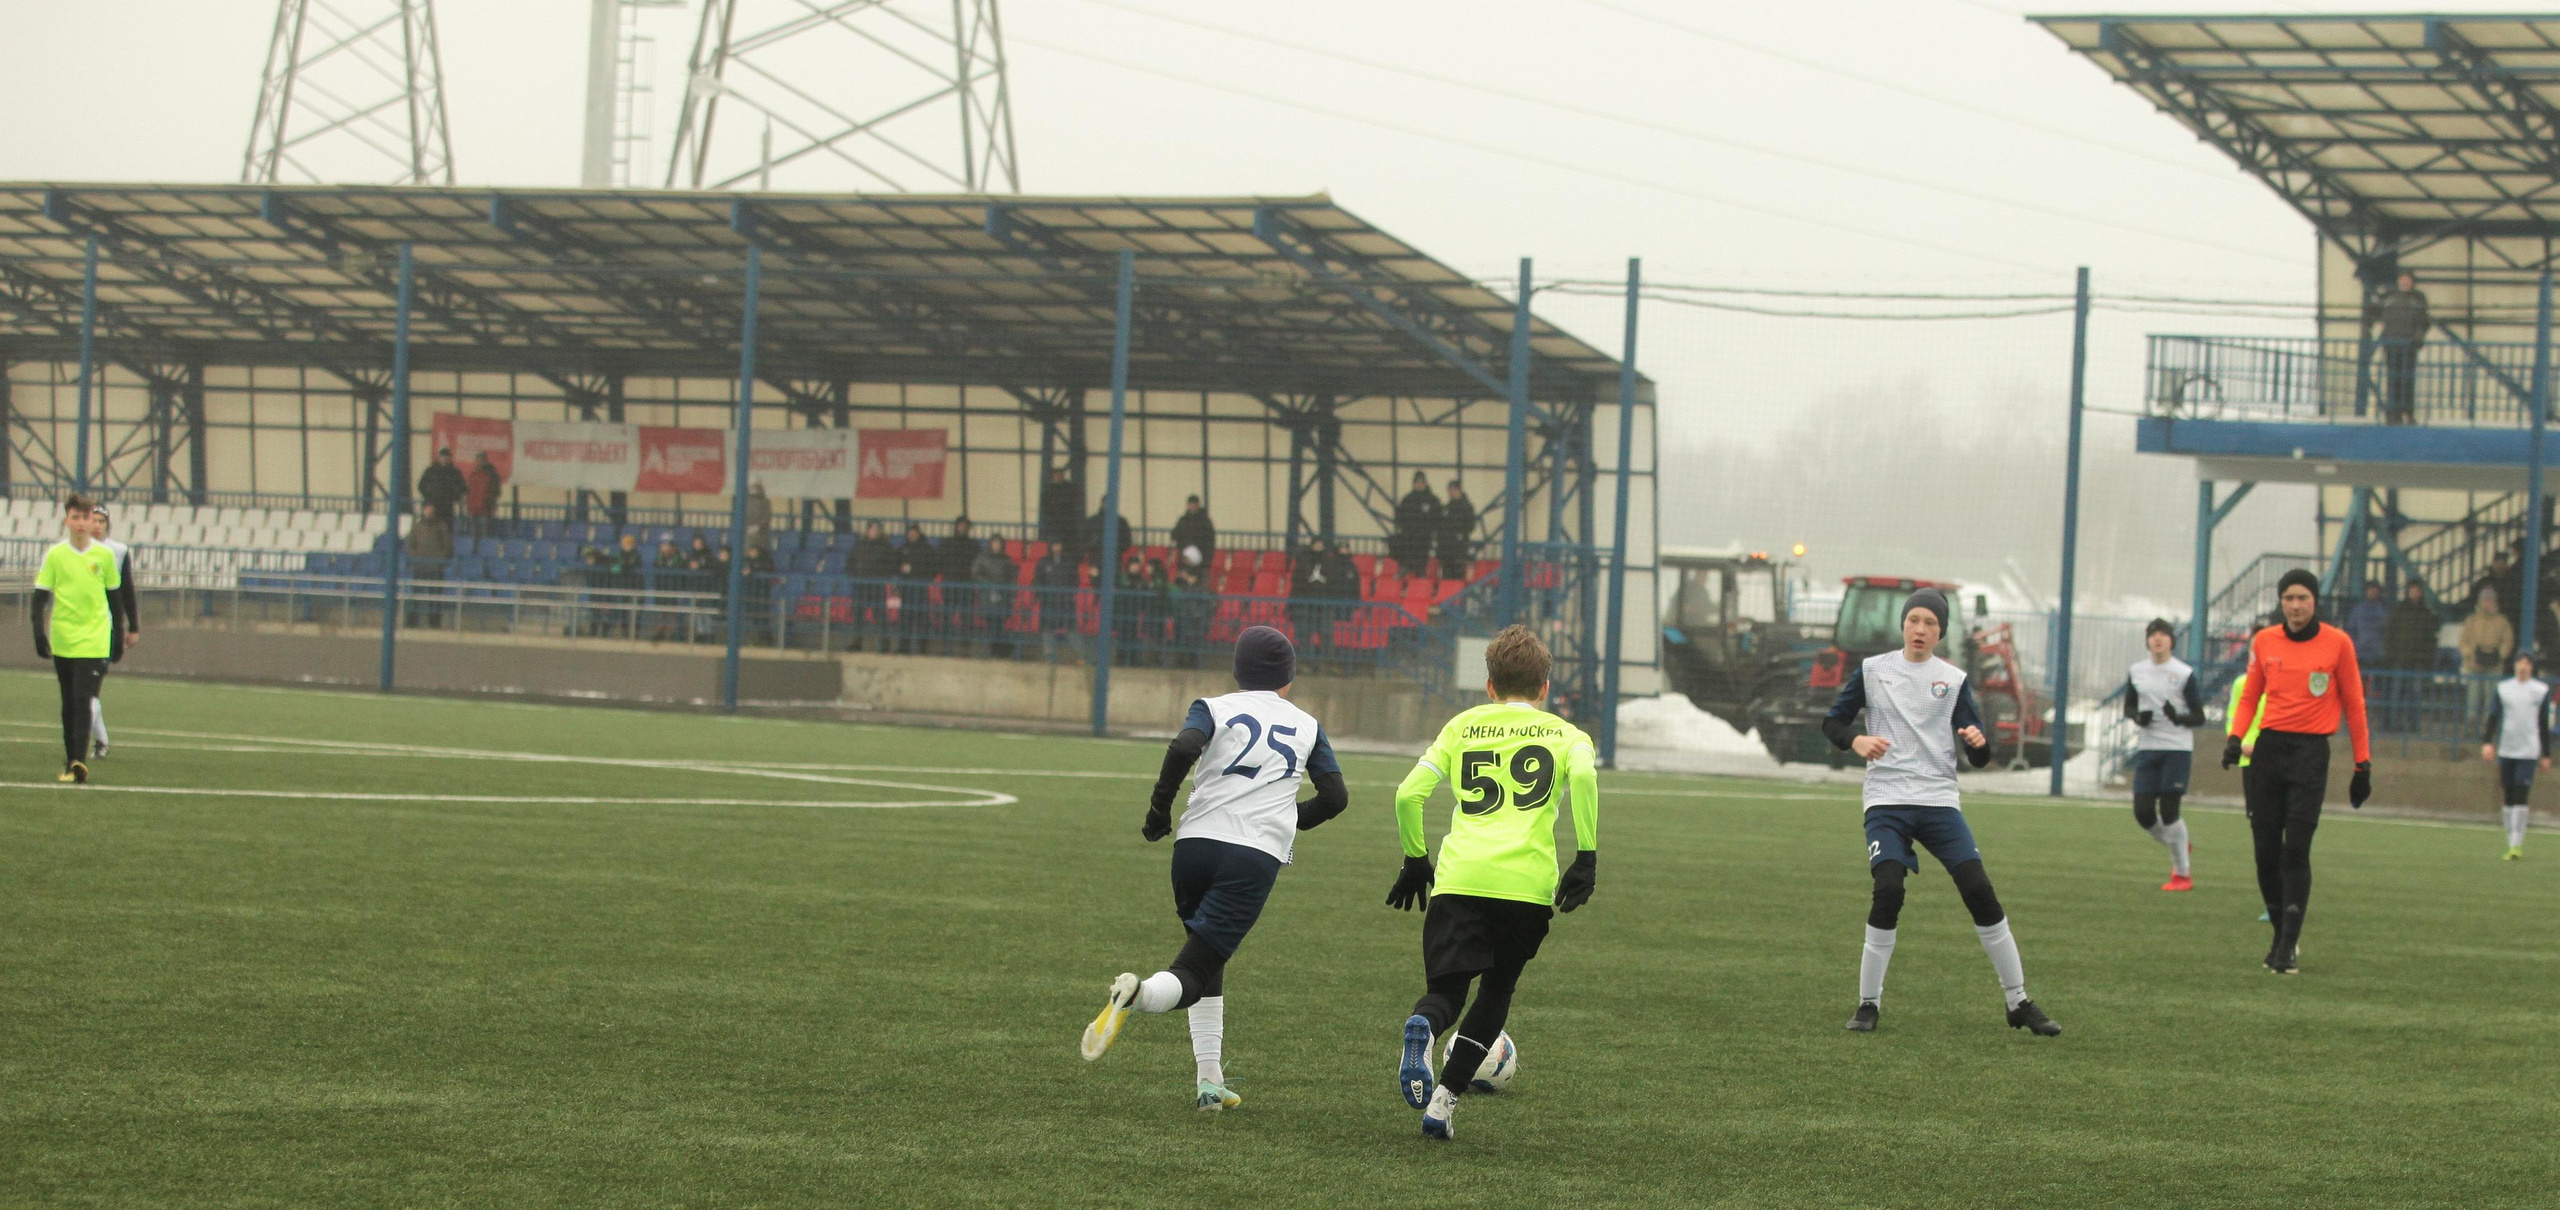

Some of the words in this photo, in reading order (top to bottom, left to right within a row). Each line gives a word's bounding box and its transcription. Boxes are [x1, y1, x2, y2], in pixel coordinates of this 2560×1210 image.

[1222, 713, 1297, 784] 25
[1461, 725, 1505, 739] СМЕНА
[1460, 744, 1556, 817] 59
